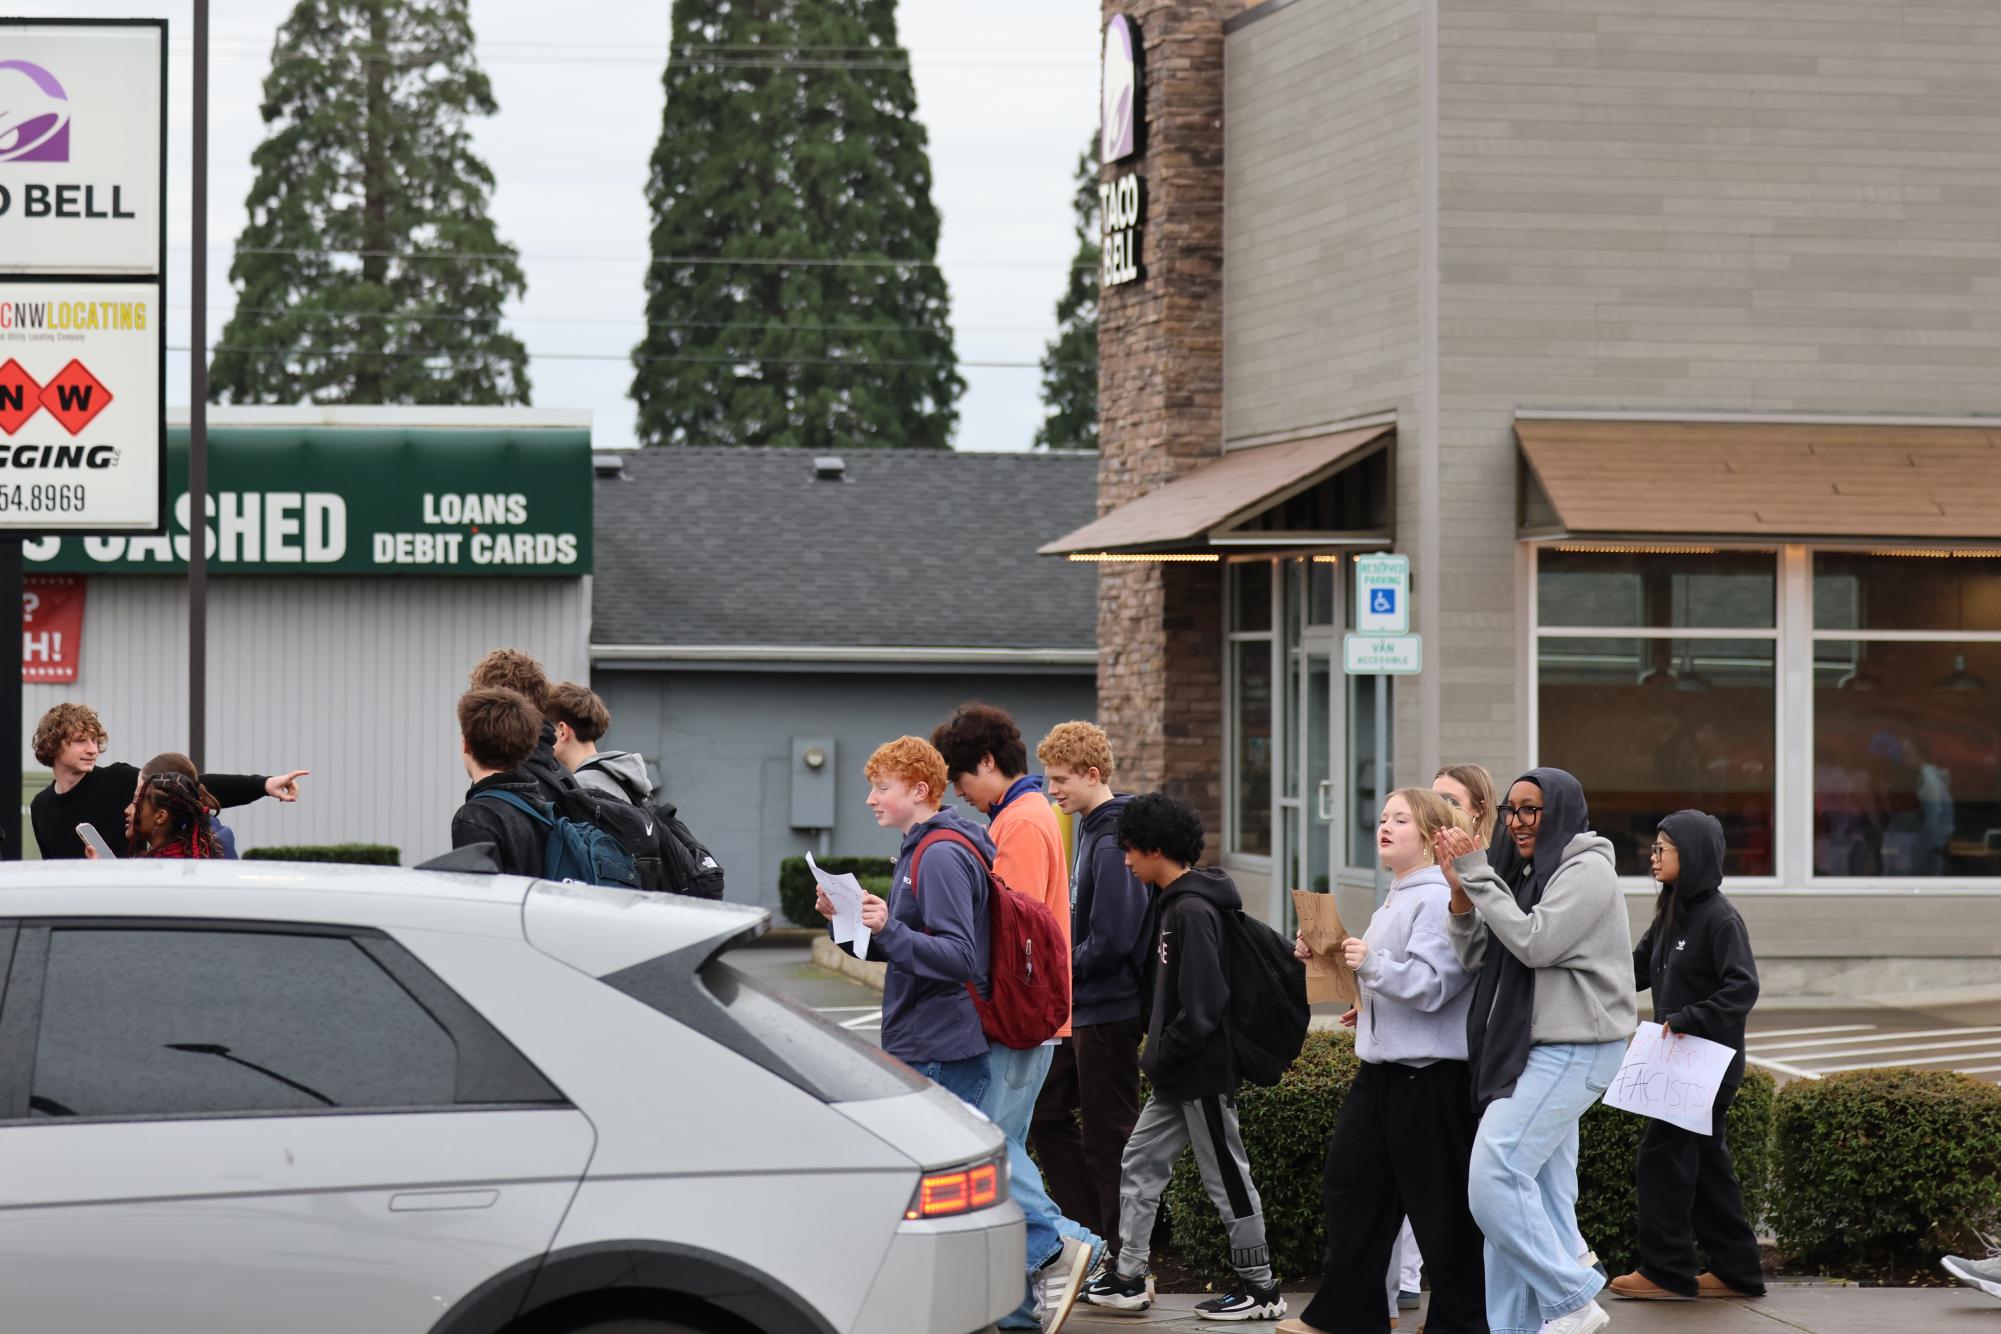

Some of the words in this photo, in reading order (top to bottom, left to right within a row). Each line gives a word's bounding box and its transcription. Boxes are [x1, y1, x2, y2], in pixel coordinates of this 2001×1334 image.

[25, 184, 136, 219] BELL
[1099, 172, 1139, 234] TACO
[1104, 227, 1138, 288] BELL
[57, 332, 86, 343] Company
[57, 385, 93, 411] W
[422, 493, 528, 525] LOANS
[372, 533, 463, 564] DEBIT
[470, 533, 578, 564] CARDS
[1360, 563, 1407, 573] RESERVED
[1364, 575, 1402, 585] PARKING
[1357, 656, 1408, 665] ACCESSIBLE
[1371, 644, 1395, 653] VAN
